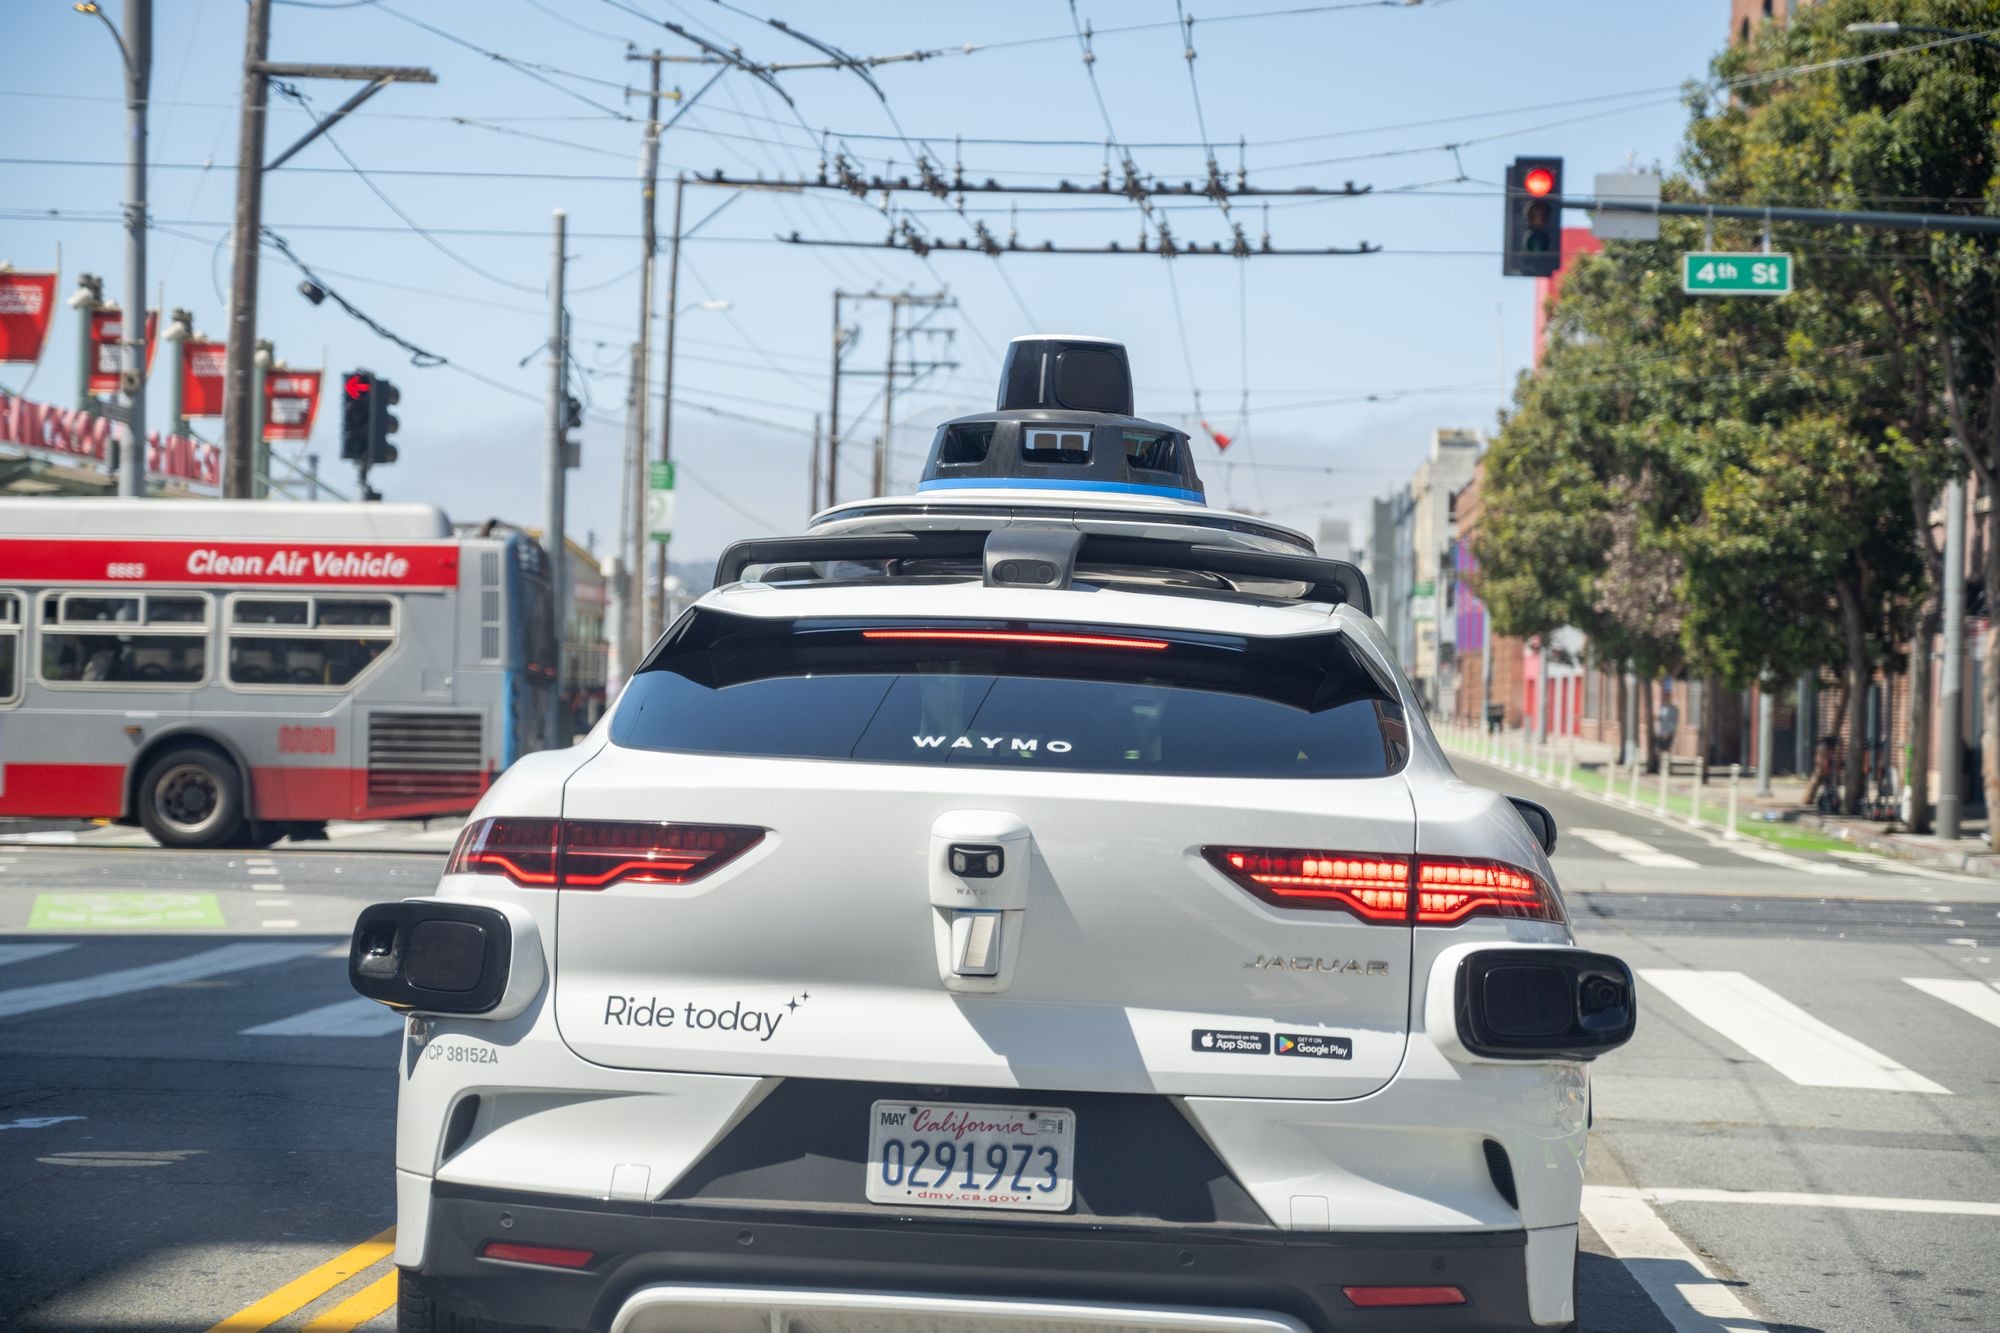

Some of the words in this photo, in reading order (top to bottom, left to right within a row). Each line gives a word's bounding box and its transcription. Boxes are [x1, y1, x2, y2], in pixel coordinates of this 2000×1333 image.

[1696, 262, 1738, 284] 4th
[1751, 262, 1779, 285] St
[187, 549, 263, 576] Clean
[266, 551, 308, 576] Air
[312, 551, 409, 578] Vehicle
[912, 735, 1072, 753] WAYMO
[956, 887, 996, 896] WAYMO
[1242, 955, 1390, 977] JAGUAR
[604, 995, 675, 1028] Ride
[684, 1001, 783, 1042] today
[1216, 1039, 1236, 1050] App
[1236, 1040, 1262, 1050] Store
[1297, 1043, 1329, 1056] Google
[1329, 1045, 1348, 1057] Play
[447, 1046, 499, 1064] 38152A
[880, 1112, 906, 1126] MAY
[912, 1109, 1038, 1140] California
[882, 1138, 1059, 1193] 02919Z3
[917, 1190, 1021, 1203] dmv.ca.gov
